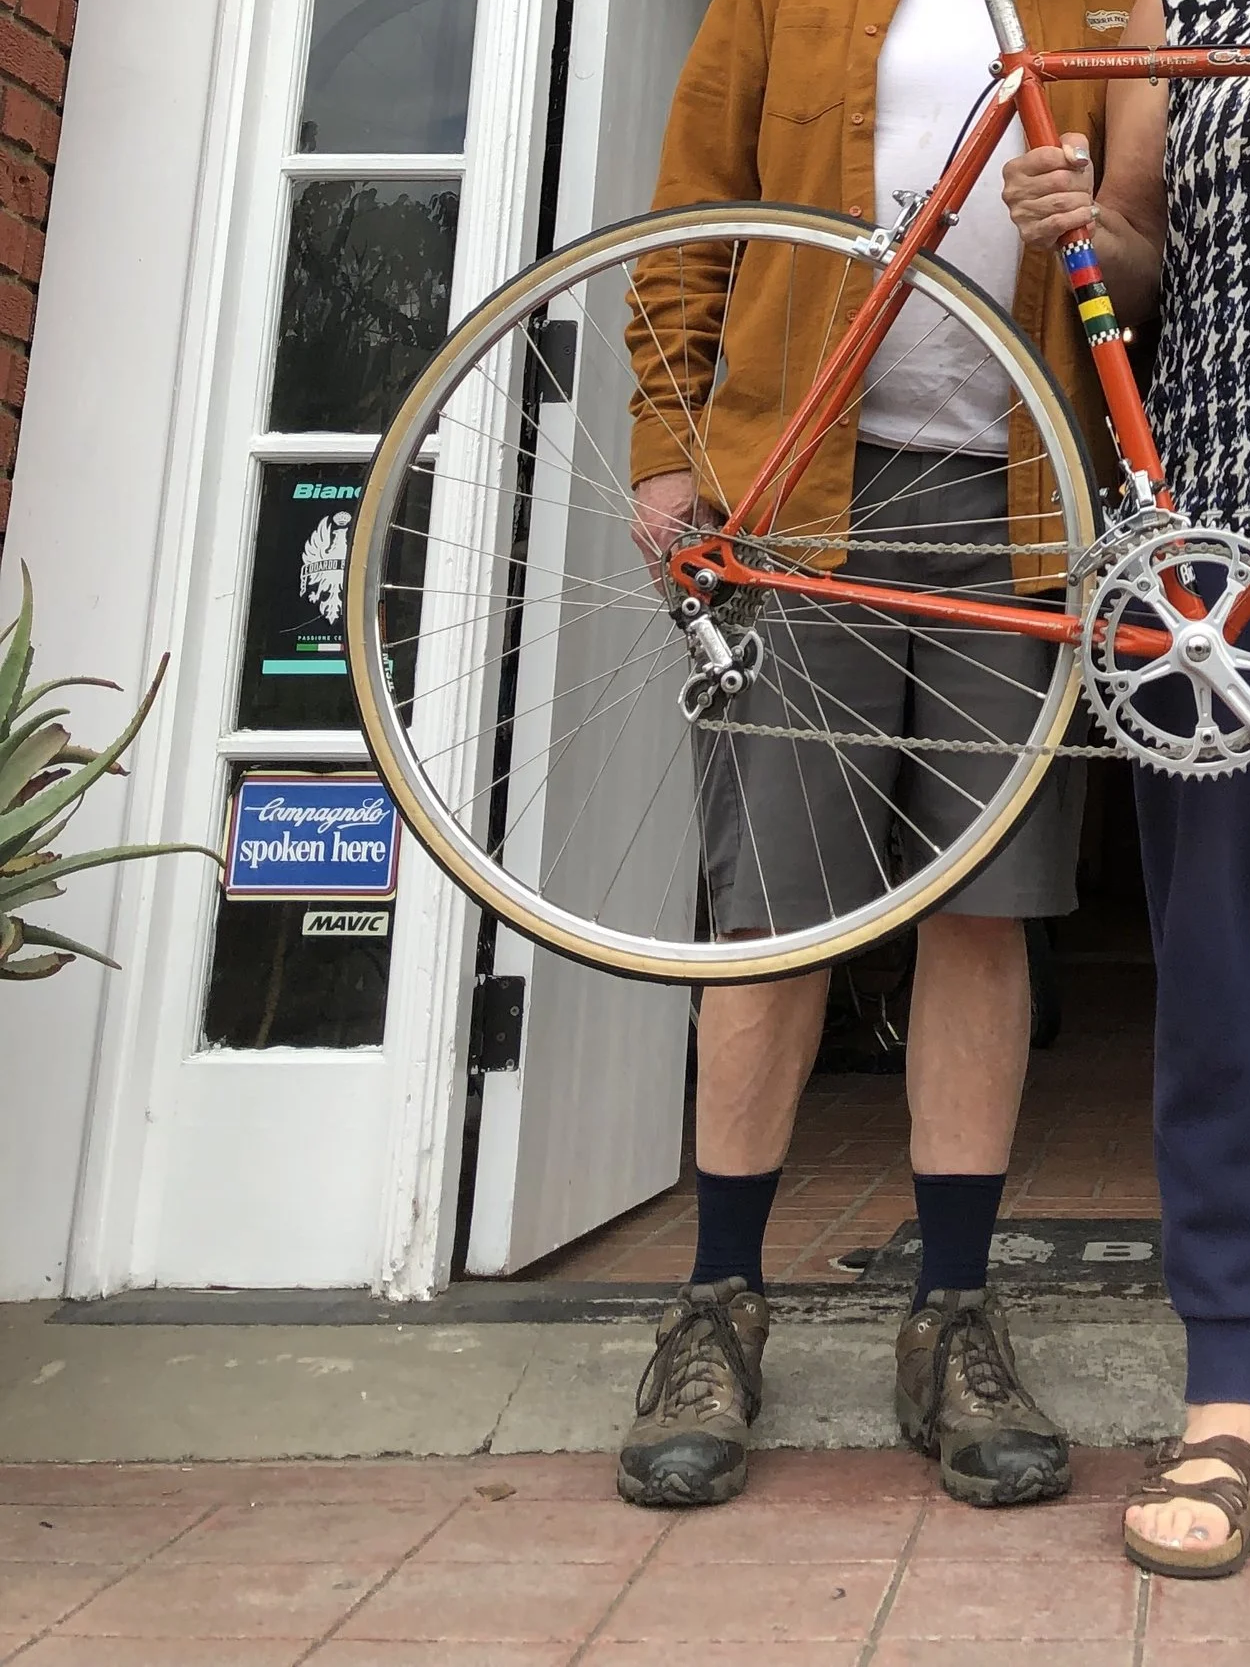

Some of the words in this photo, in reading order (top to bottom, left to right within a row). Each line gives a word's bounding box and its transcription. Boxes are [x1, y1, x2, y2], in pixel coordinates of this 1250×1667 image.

[293, 483, 362, 499] Bian
[244, 797, 391, 834] Campagnolo
[239, 831, 325, 869] spoken
[331, 831, 386, 863] here
[307, 916, 385, 932] MAVIC
